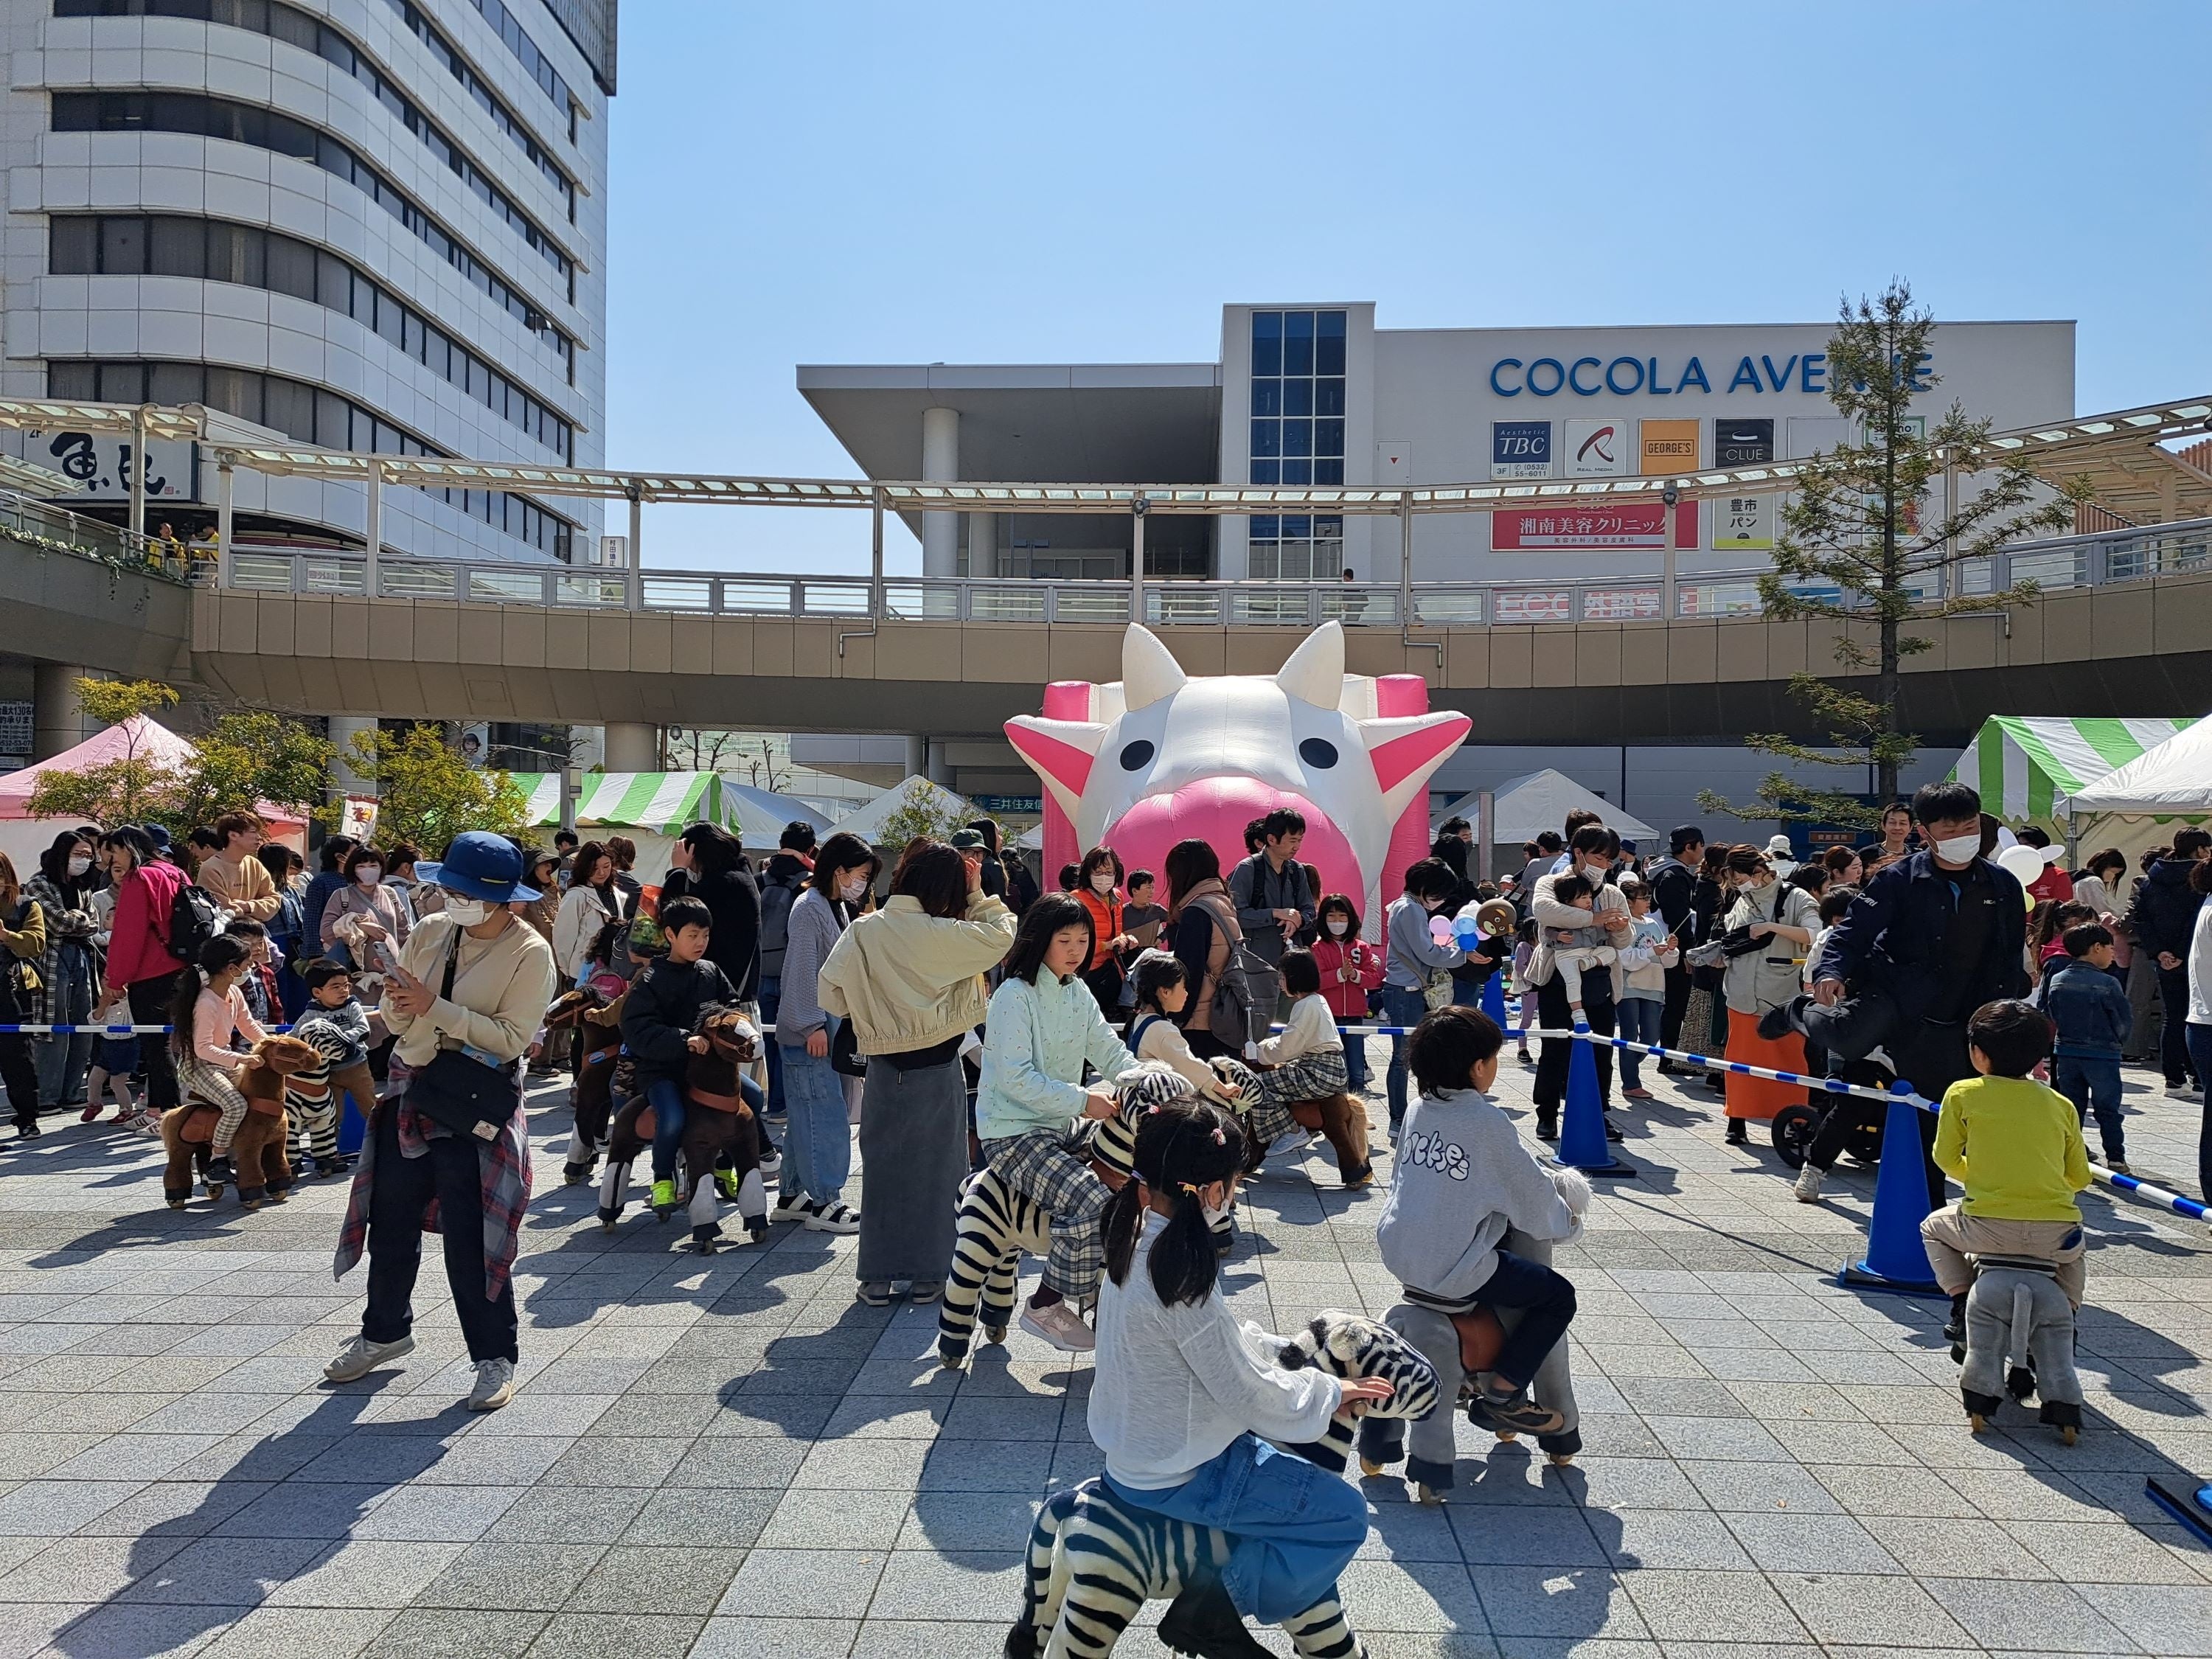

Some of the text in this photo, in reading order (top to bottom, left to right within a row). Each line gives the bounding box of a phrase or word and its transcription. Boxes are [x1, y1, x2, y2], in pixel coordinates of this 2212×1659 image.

[1490, 356, 1711, 397] COCOLA
[1499, 437, 1546, 455] TBC
[1648, 443, 1691, 453] GEORGE'S
[1726, 449, 1764, 461] CLUE
[1730, 498, 1757, 512] 豊市
[1730, 517, 1757, 528] パン
[990, 799, 1043, 810] 三井住友信
[1351, 947, 1362, 964] S
